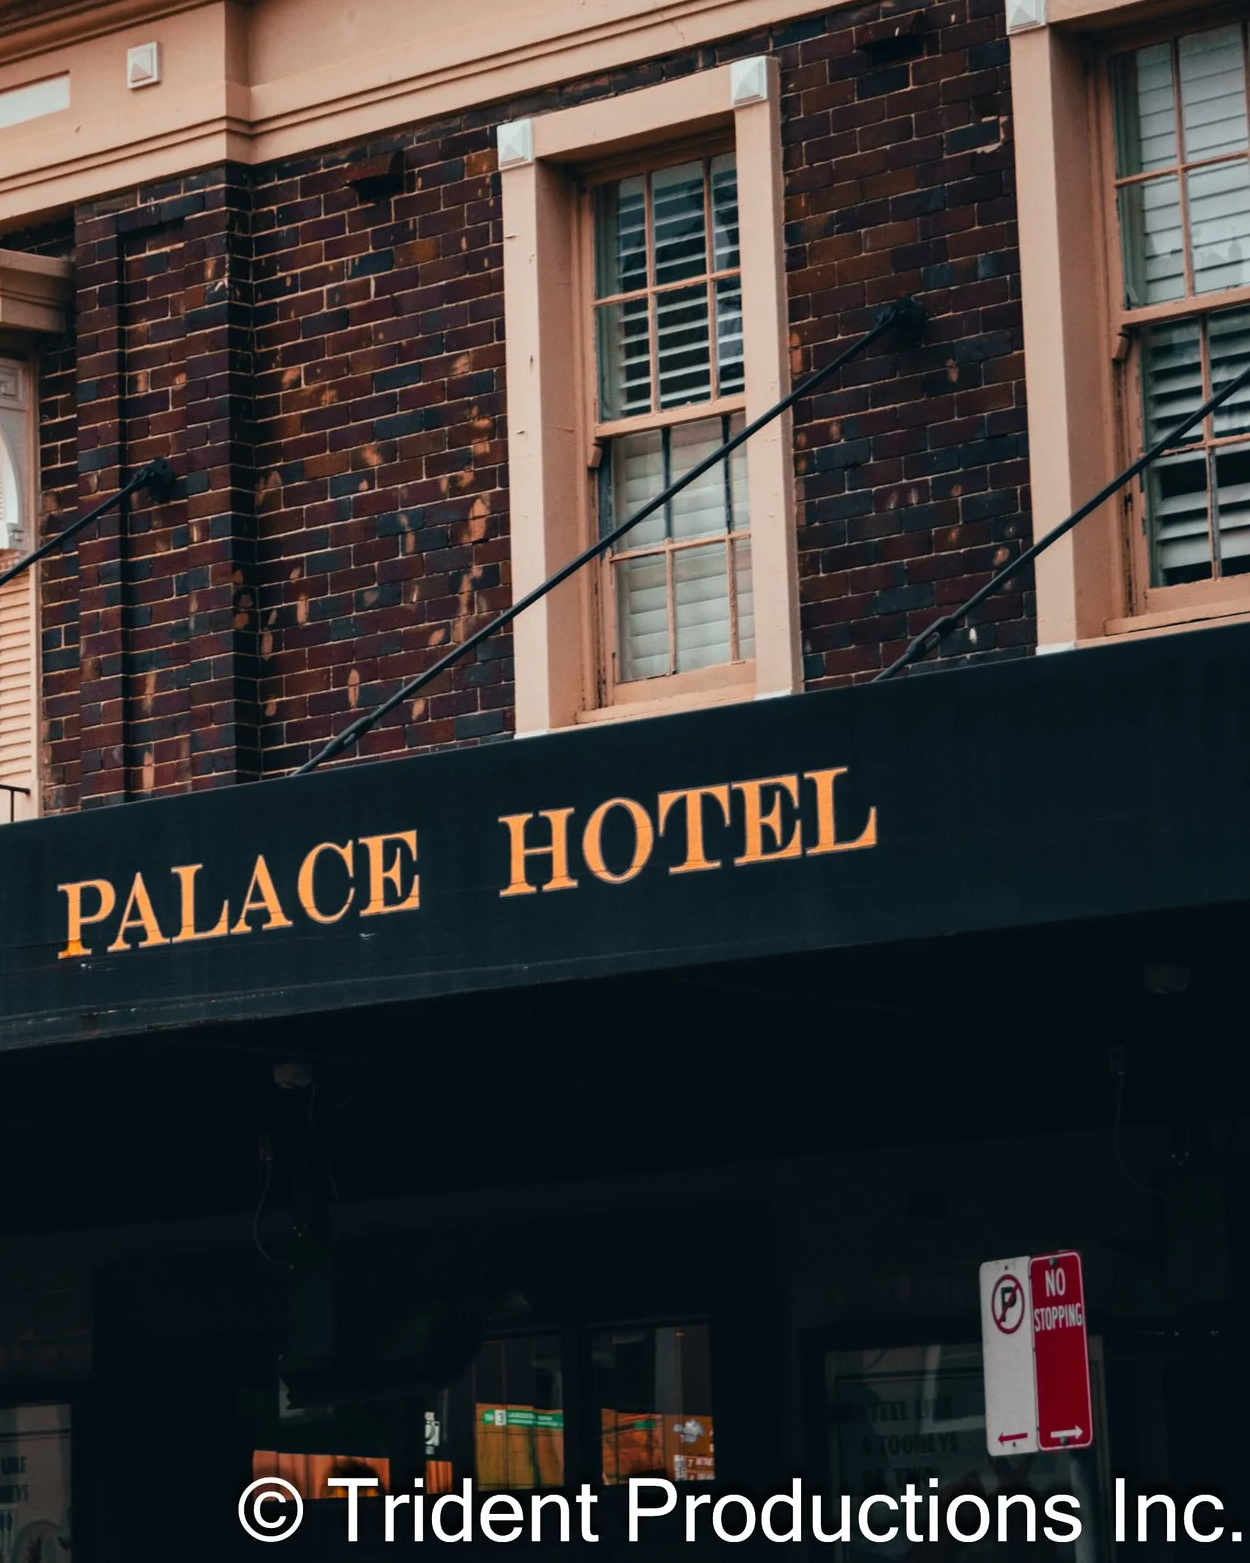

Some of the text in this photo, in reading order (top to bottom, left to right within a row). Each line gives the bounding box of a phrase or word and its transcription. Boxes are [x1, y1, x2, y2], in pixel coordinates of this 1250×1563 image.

[59, 830, 419, 958] PALACE
[499, 768, 876, 896] HOTEL
[1045, 1267, 1066, 1297] NO
[1033, 1302, 1083, 1332] STOPPING
